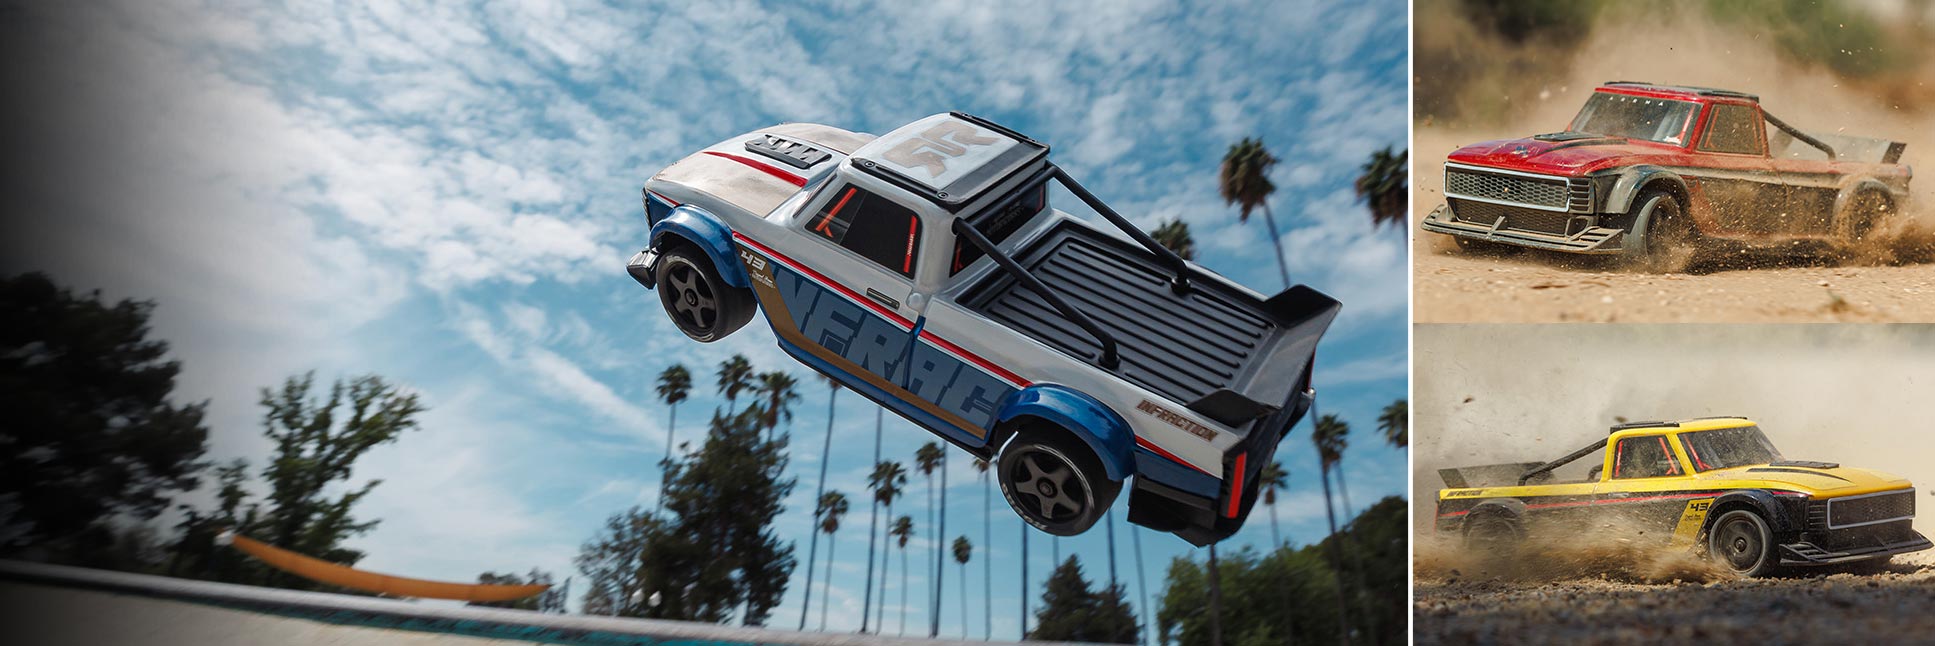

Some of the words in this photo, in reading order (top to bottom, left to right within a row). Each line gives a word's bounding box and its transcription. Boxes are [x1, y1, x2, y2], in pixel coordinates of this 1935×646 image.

[741, 250, 767, 271] 43
[773, 265, 1009, 429] NFRAC
[1136, 399, 1219, 442] INFRACTION
[1690, 502, 1710, 512] 43
